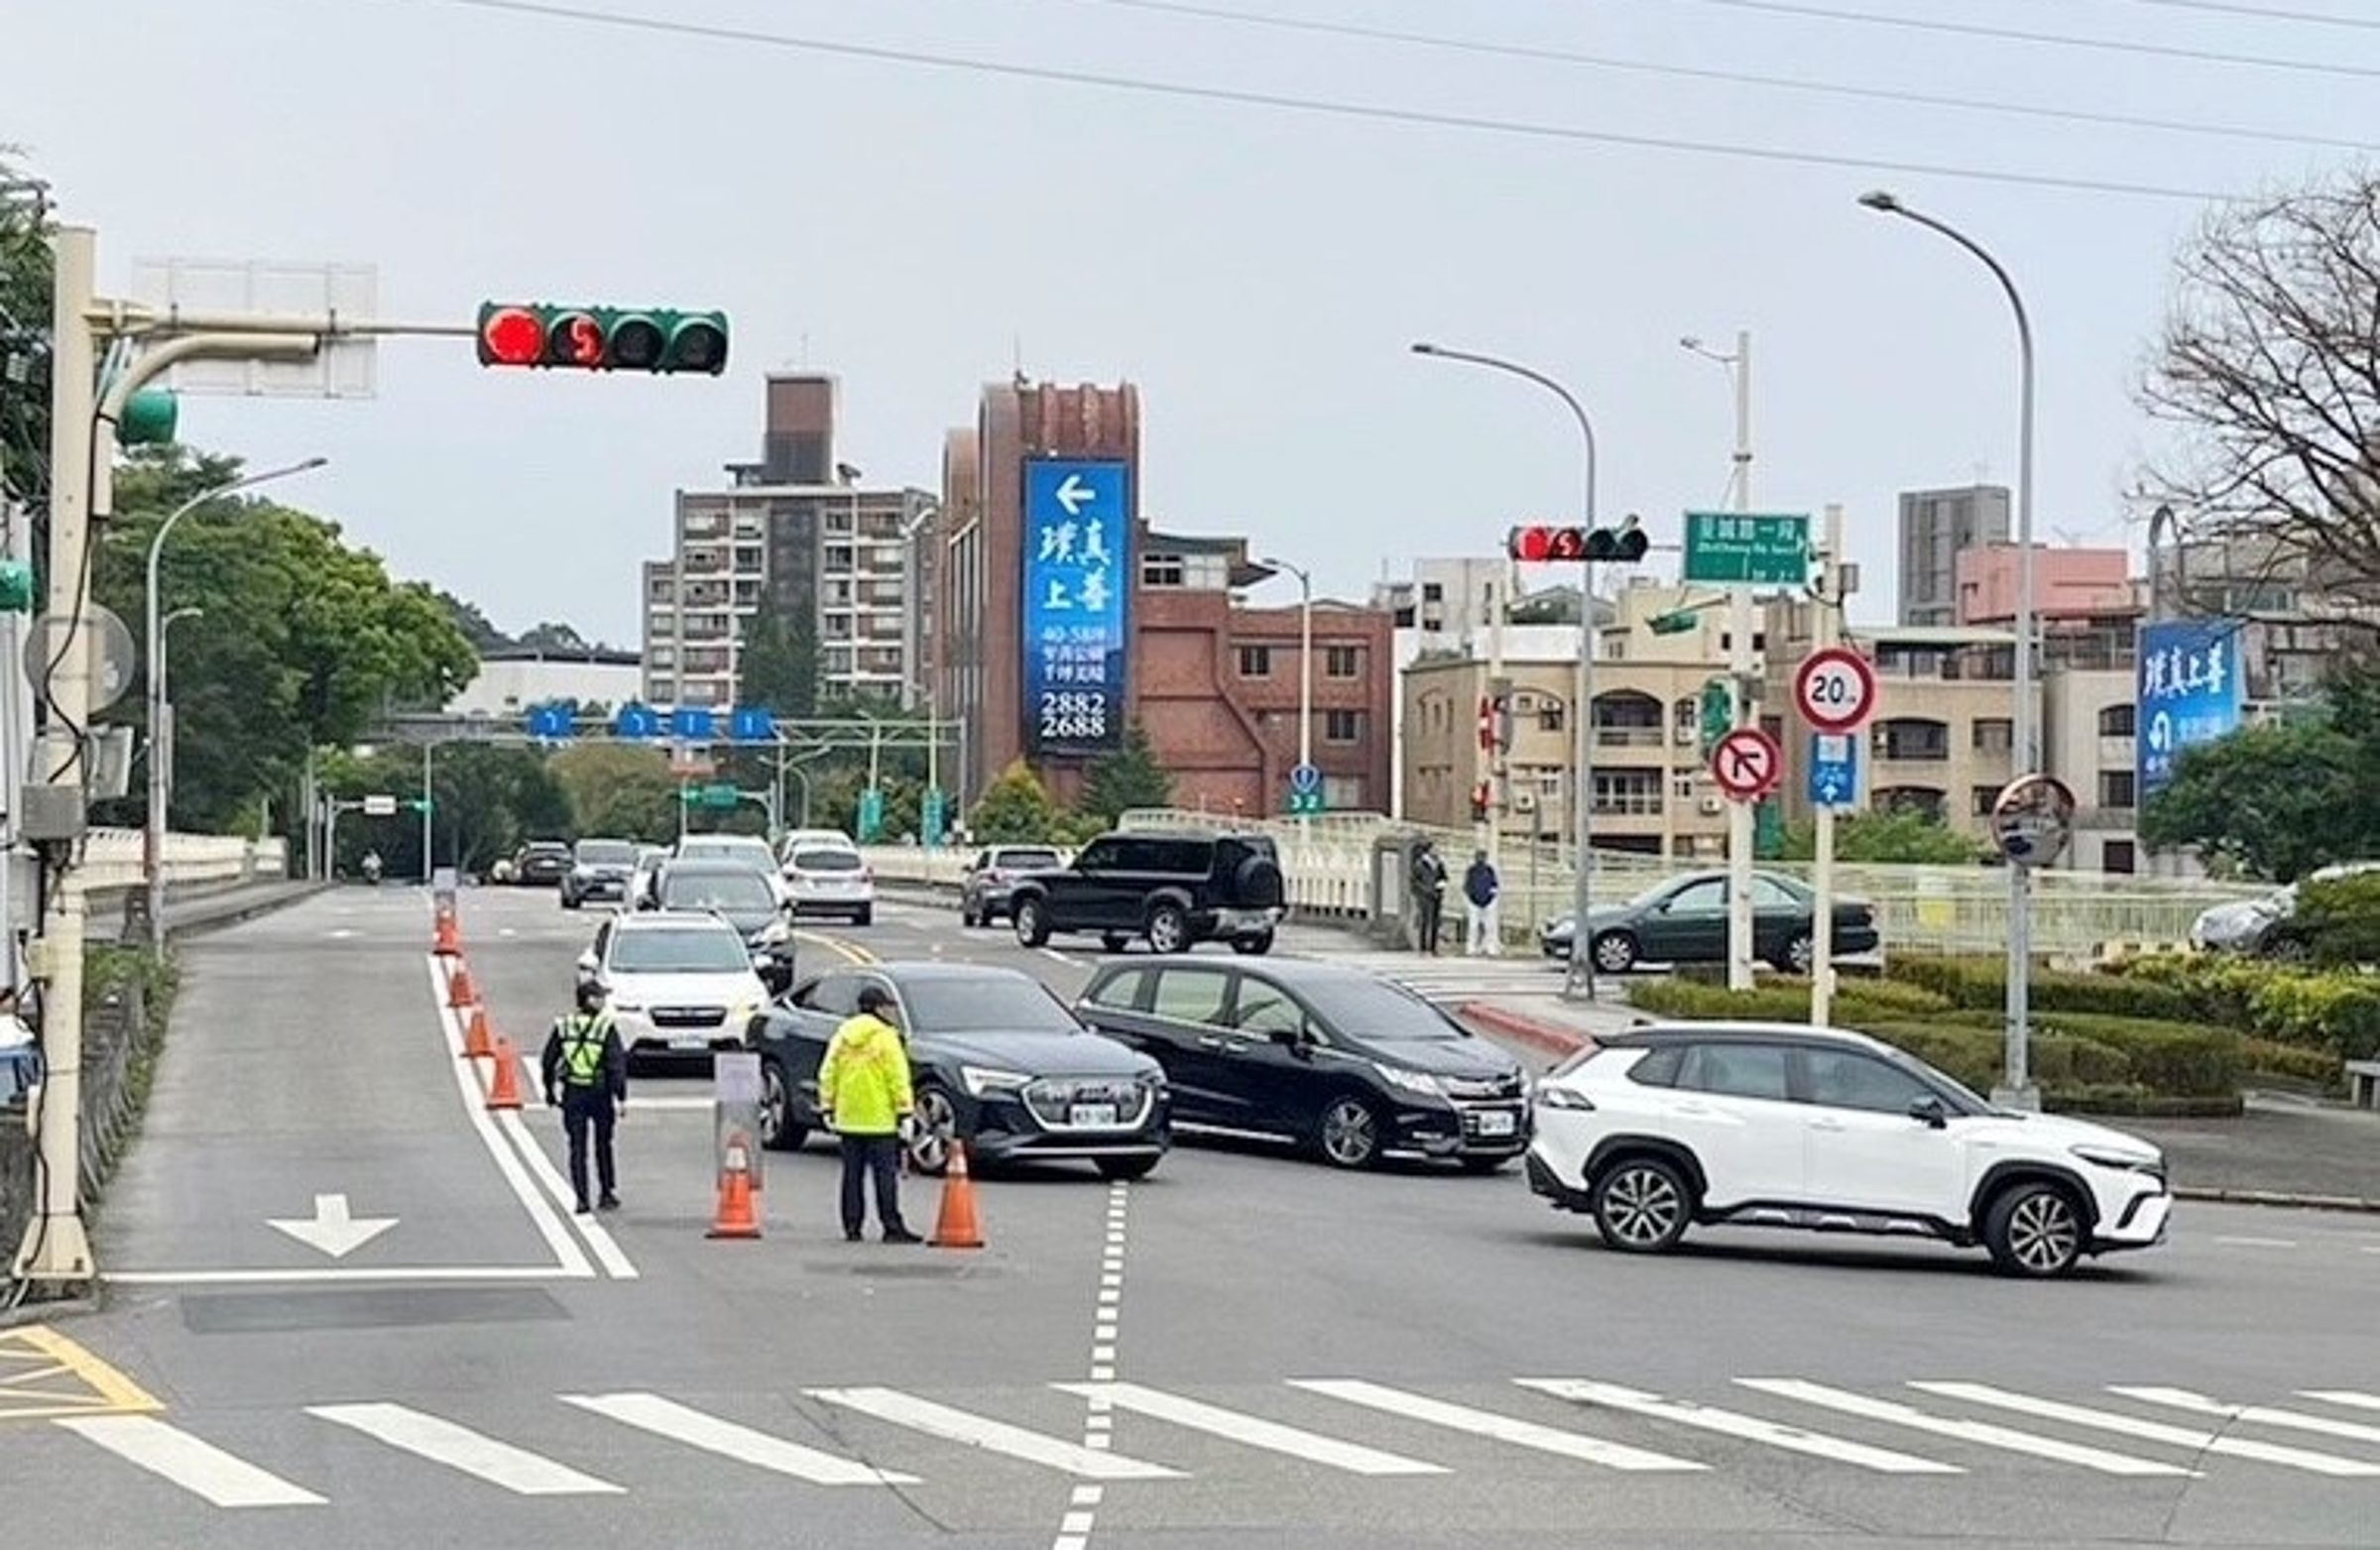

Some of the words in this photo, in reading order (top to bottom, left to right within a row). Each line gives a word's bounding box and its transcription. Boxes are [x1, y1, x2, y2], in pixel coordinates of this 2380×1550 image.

[1812, 675, 1844, 704] 20
[1041, 692, 1106, 714] 2882
[1041, 716, 1106, 737] 2688
